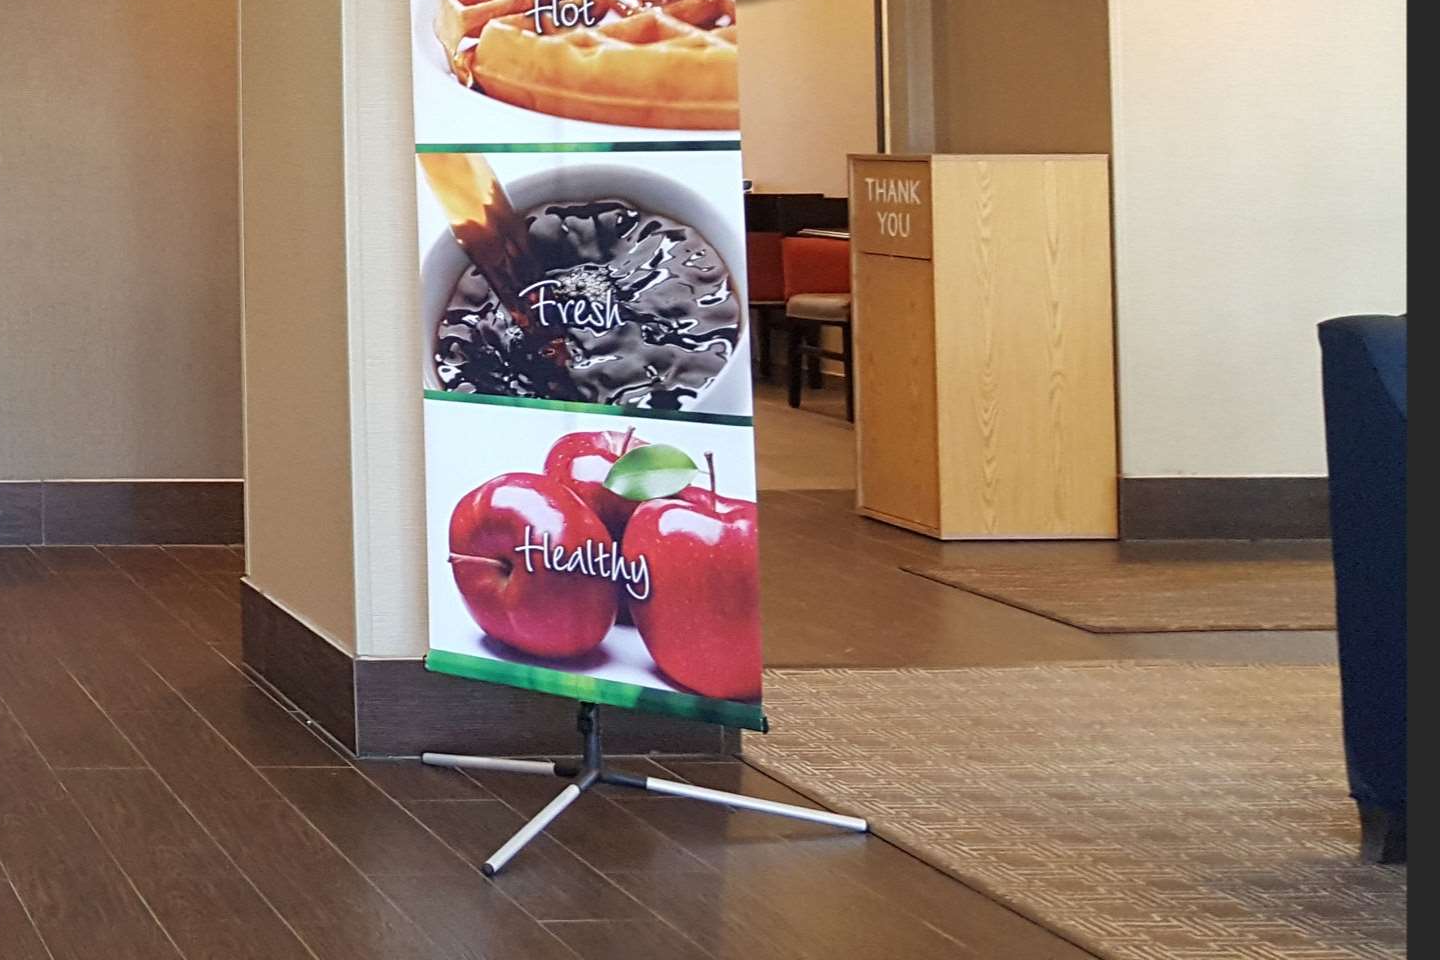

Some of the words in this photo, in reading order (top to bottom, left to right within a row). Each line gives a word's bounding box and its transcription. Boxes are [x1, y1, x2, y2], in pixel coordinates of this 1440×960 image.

[865, 177, 921, 205] THANK
[877, 211, 910, 238] YOU
[519, 280, 626, 329] Fresh
[514, 525, 650, 600] Healthy
